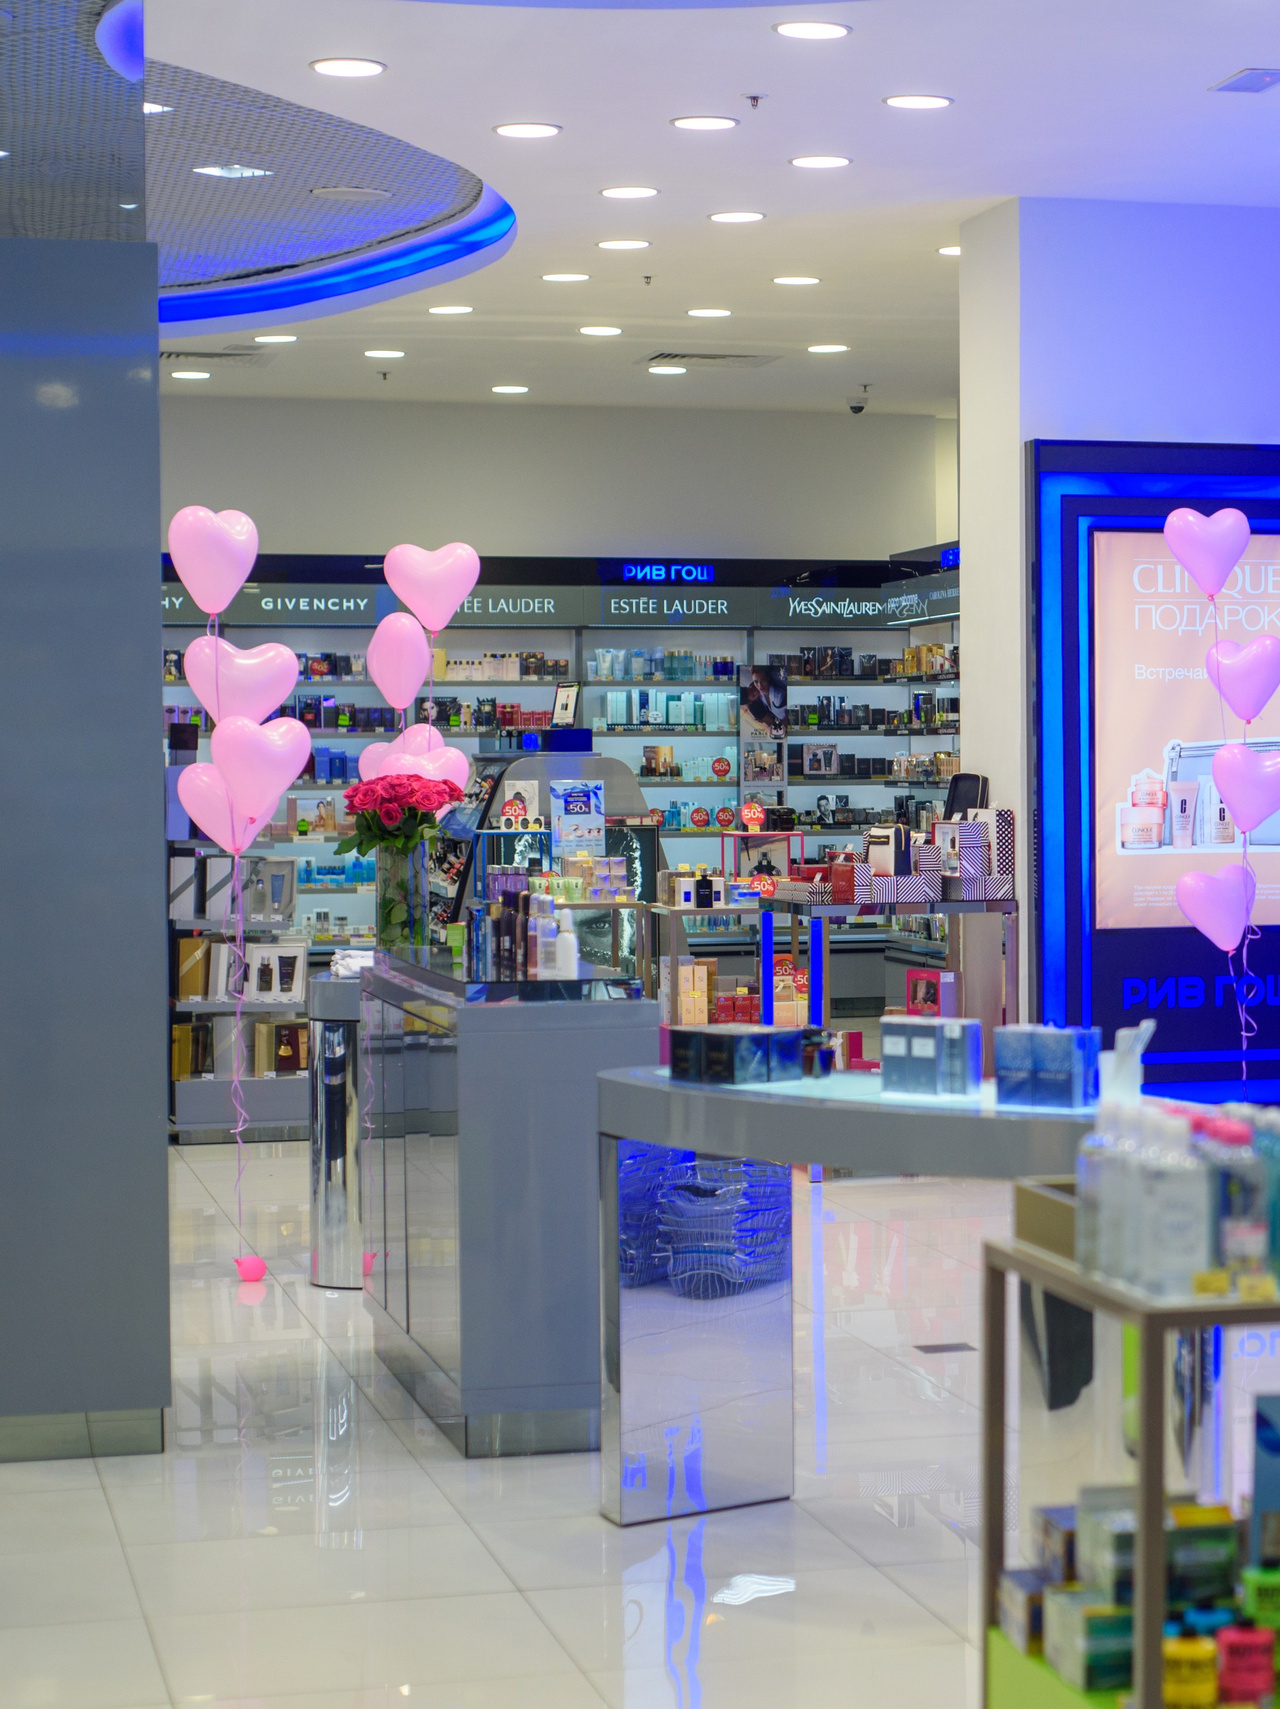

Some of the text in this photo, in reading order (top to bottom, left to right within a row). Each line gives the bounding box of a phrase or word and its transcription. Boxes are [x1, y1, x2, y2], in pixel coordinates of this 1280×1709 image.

[623, 564, 714, 581] РИВ ГОШ
[261, 598, 368, 610] GIVENCHY
[488, 598, 555, 613] LAUDER
[663, 599, 728, 614] LAUDER
[1122, 976, 1206, 1010] РИВ
